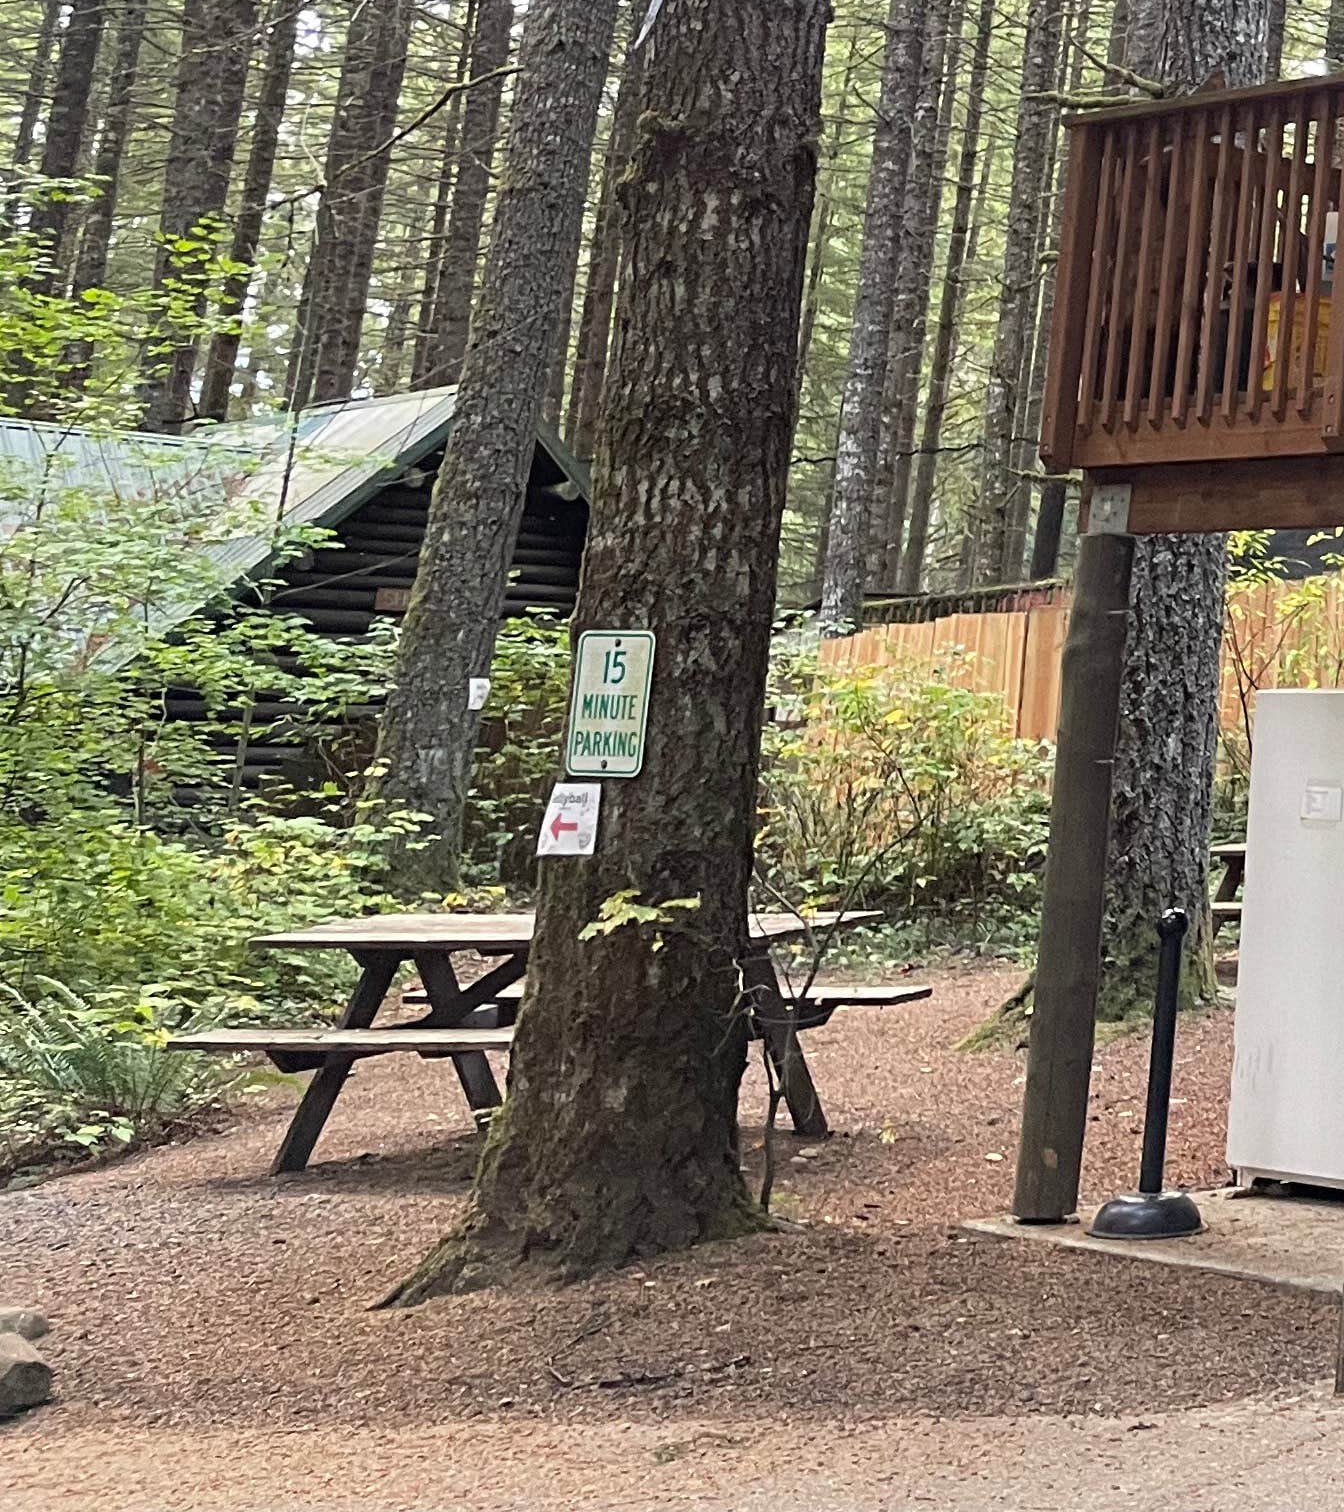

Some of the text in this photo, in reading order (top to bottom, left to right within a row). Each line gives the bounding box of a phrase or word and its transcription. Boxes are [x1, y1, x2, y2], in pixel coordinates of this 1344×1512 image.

[602, 650, 627, 685] 15
[581, 693, 638, 720] MINUTE
[573, 730, 638, 758] PARKING
